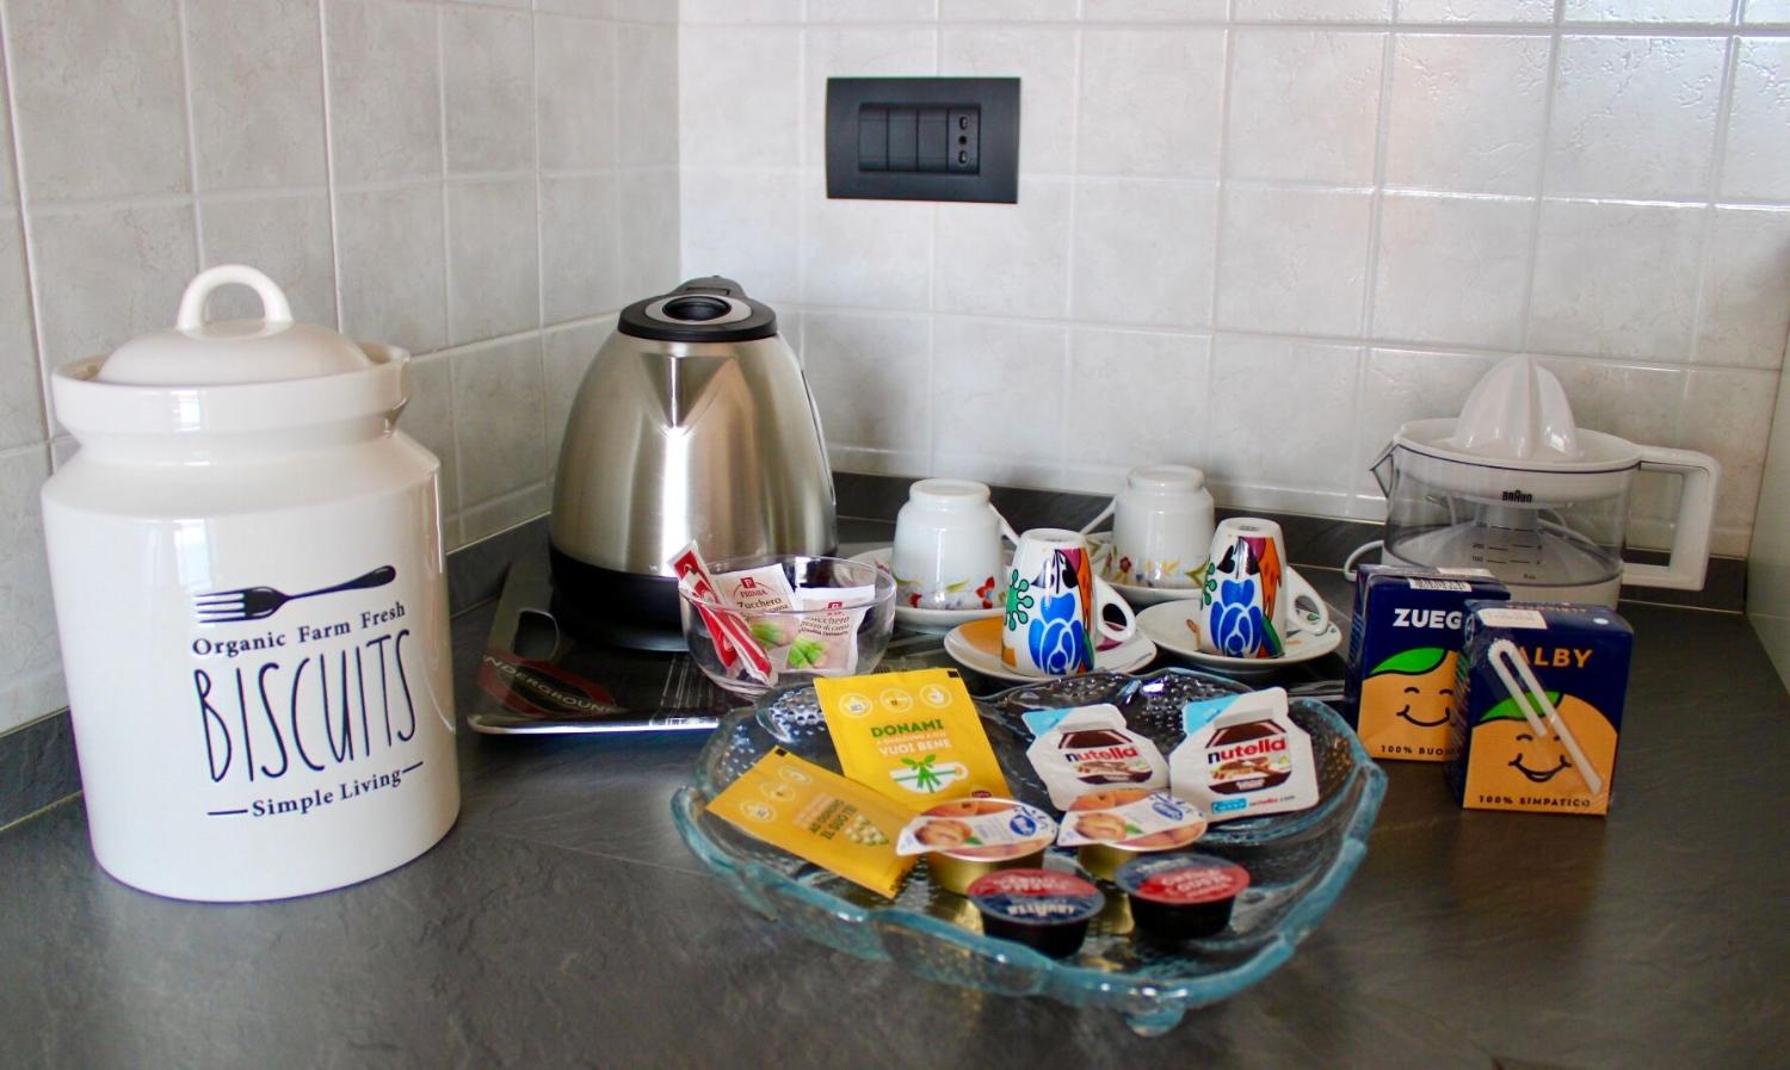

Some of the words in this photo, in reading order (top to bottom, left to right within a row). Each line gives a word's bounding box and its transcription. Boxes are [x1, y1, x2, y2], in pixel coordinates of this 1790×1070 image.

[1392, 608, 1463, 630] ZUEG
[192, 631, 287, 658] Organic
[297, 620, 351, 643] Farm
[361, 601, 406, 629] Fresh
[193, 629, 416, 783] BISCUITS
[870, 719, 944, 738] DONAMI
[879, 743, 915, 756] VUOI
[917, 739, 953, 752] BENE
[1065, 747, 1138, 762] nutella
[1207, 738, 1286, 764] nutella
[1380, 744, 1413, 754] 100%
[1418, 747, 1447, 756] BUO
[252, 789, 334, 817] Simple
[340, 769, 402, 801] Living
[1479, 795, 1513, 804] 100%
[1519, 797, 1591, 808] SIMPATICO
